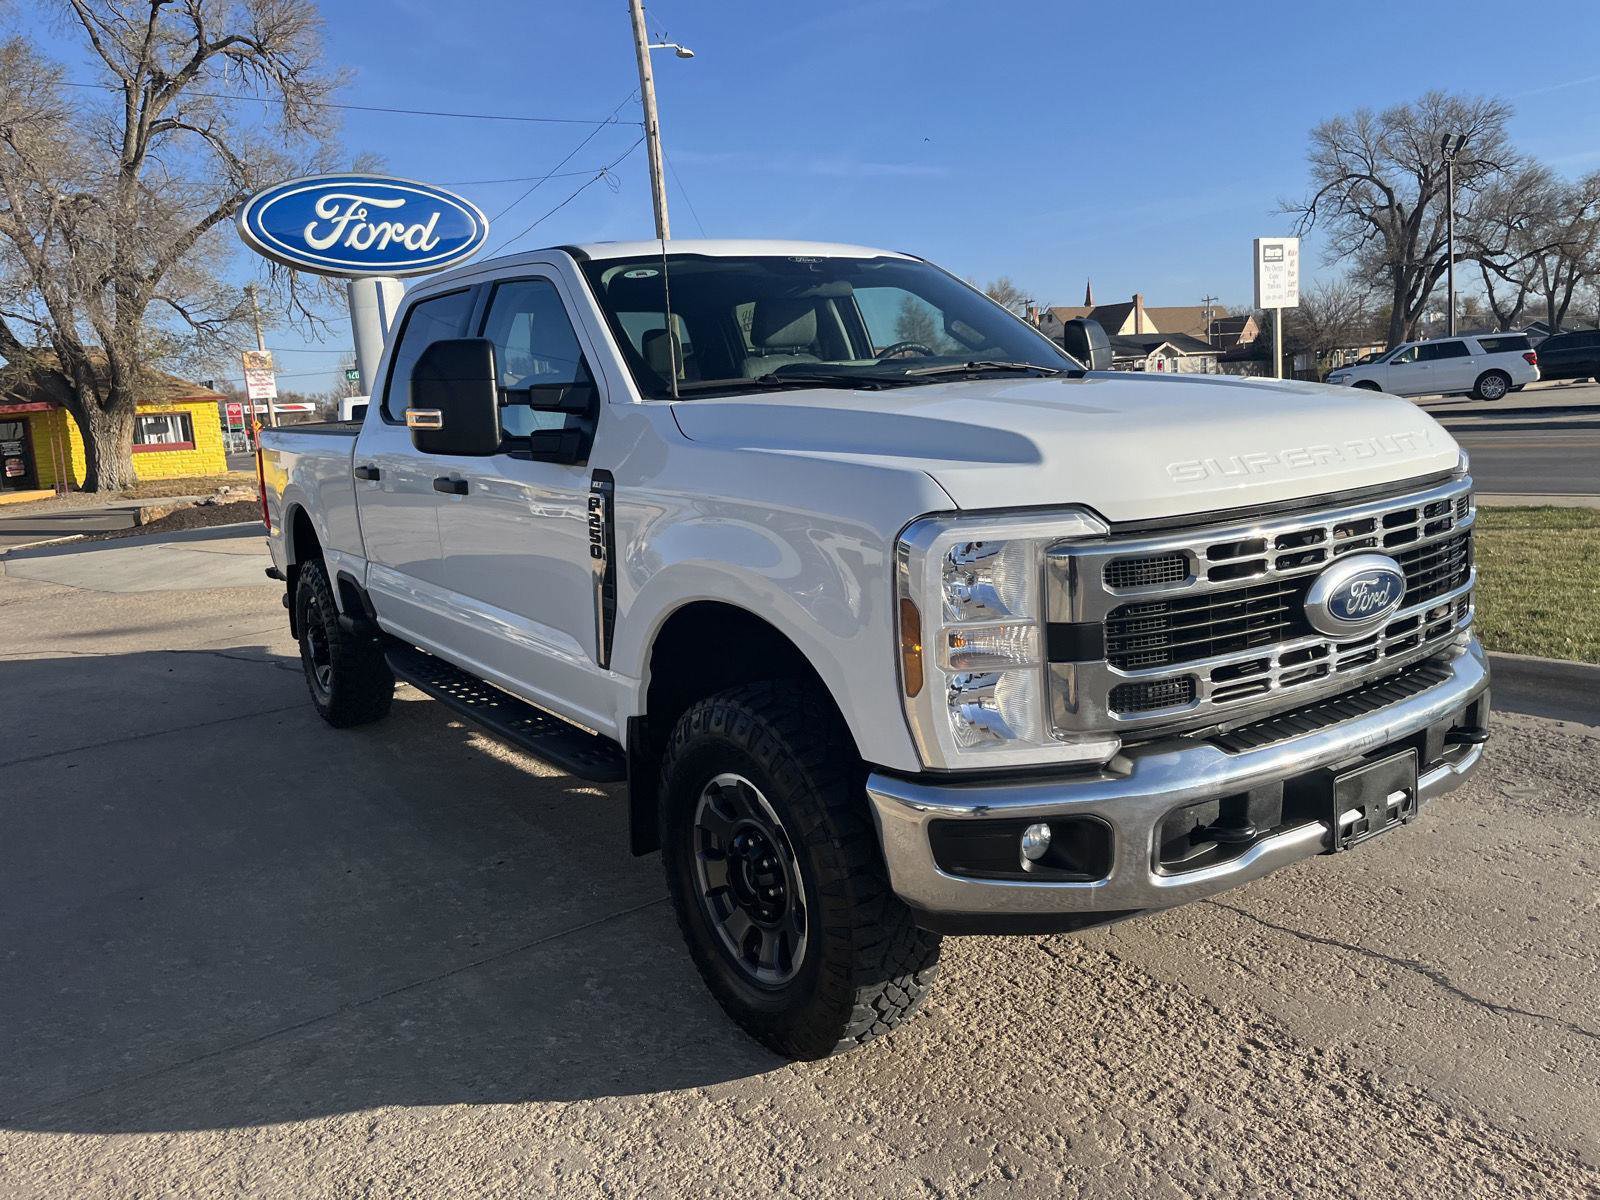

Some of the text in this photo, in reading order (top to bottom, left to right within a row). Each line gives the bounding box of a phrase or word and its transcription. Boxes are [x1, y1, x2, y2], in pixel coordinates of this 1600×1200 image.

[304, 194, 441, 251] Ford
[1166, 429, 1435, 483] SUPER DUTY
[1346, 577, 1391, 615] Ford
